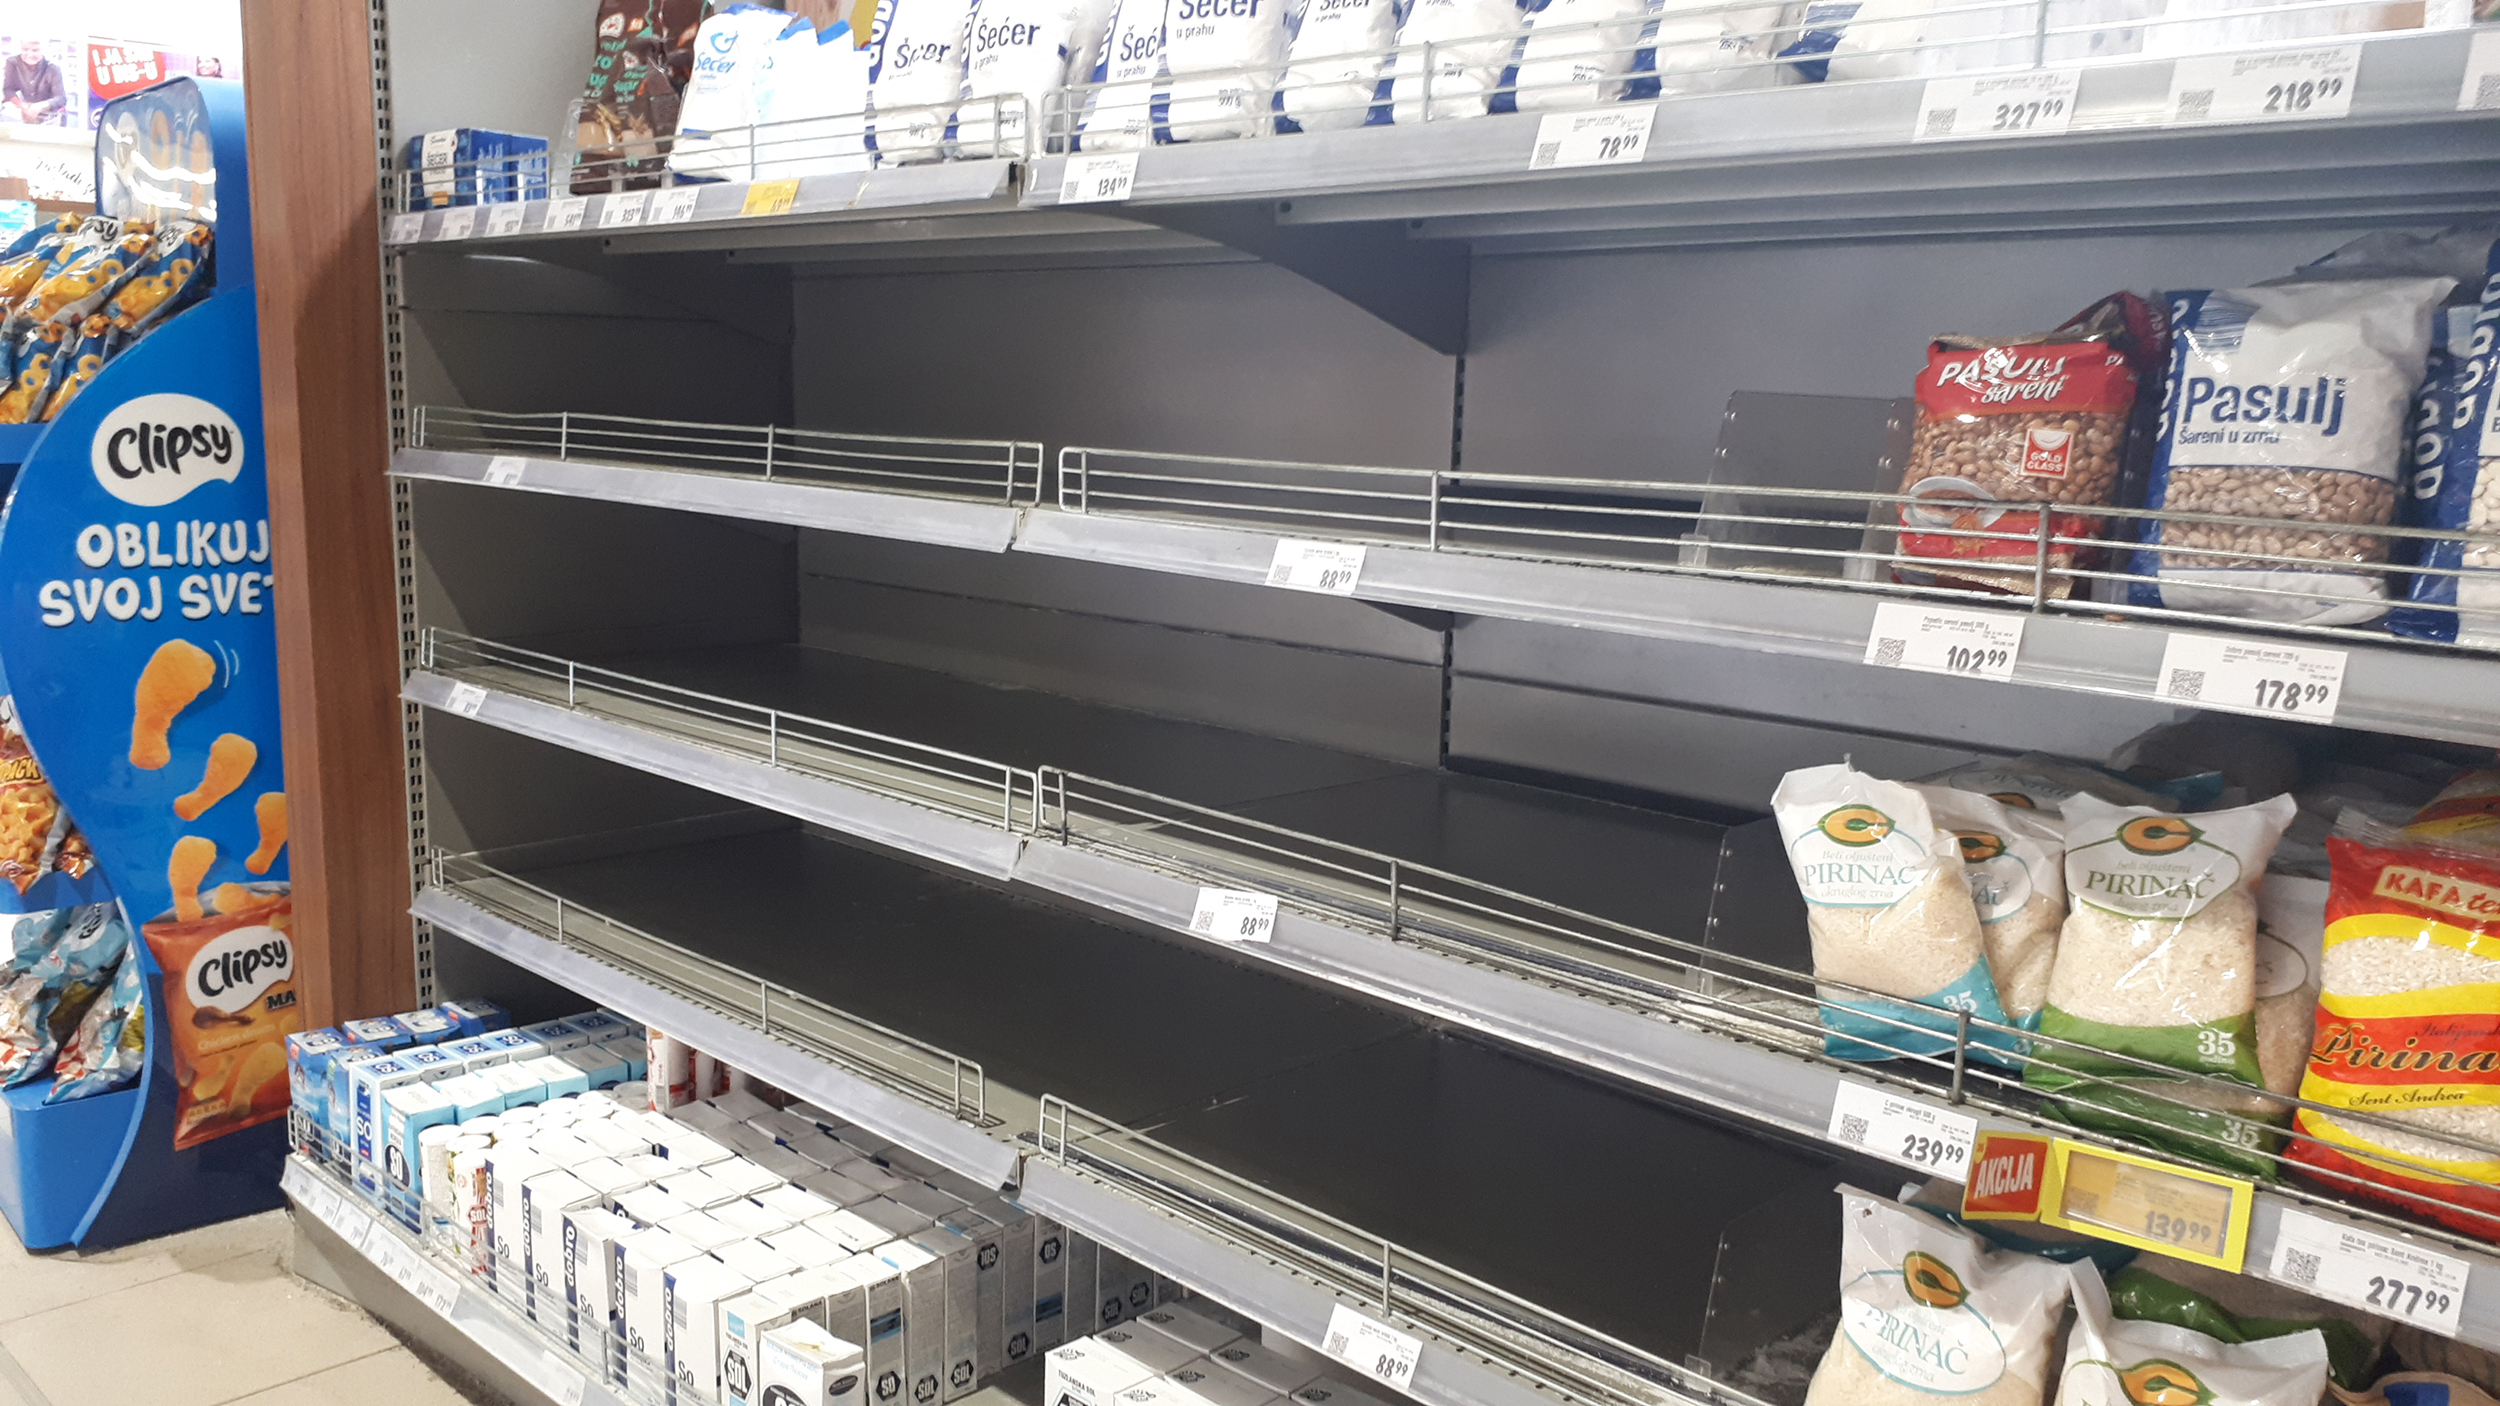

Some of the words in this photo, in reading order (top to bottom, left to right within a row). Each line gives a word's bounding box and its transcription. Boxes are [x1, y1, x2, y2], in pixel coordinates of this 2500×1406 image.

[976, 17, 1041, 53] Šećer
[1185, 24, 1215, 40] prahu
[2182, 376, 2349, 437] Pasulj
[107, 422, 234, 479] Clipsy
[2178, 427, 2225, 445] Šareni
[2228, 430, 2239, 443] u
[76, 520, 269, 568] OBLIKUJ
[39, 575, 163, 627] SVOJ
[180, 572, 273, 619] SVE
[1803, 859, 1917, 886] PIRINAČ
[2084, 870, 2215, 899] PIRINAČ
[198, 939, 288, 997] Clipsy
[2197, 1030, 2236, 1056] 35
[356, 1116, 373, 1141] SO
[1973, 1152, 2035, 1199] AKCIJA
[486, 1171, 494, 1230] dobro
[522, 1197, 531, 1257] dobro
[564, 1226, 576, 1287] dobro
[615, 1256, 625, 1319] dobro
[664, 1287, 674, 1351] dobro
[726, 1357, 748, 1395] SOL
